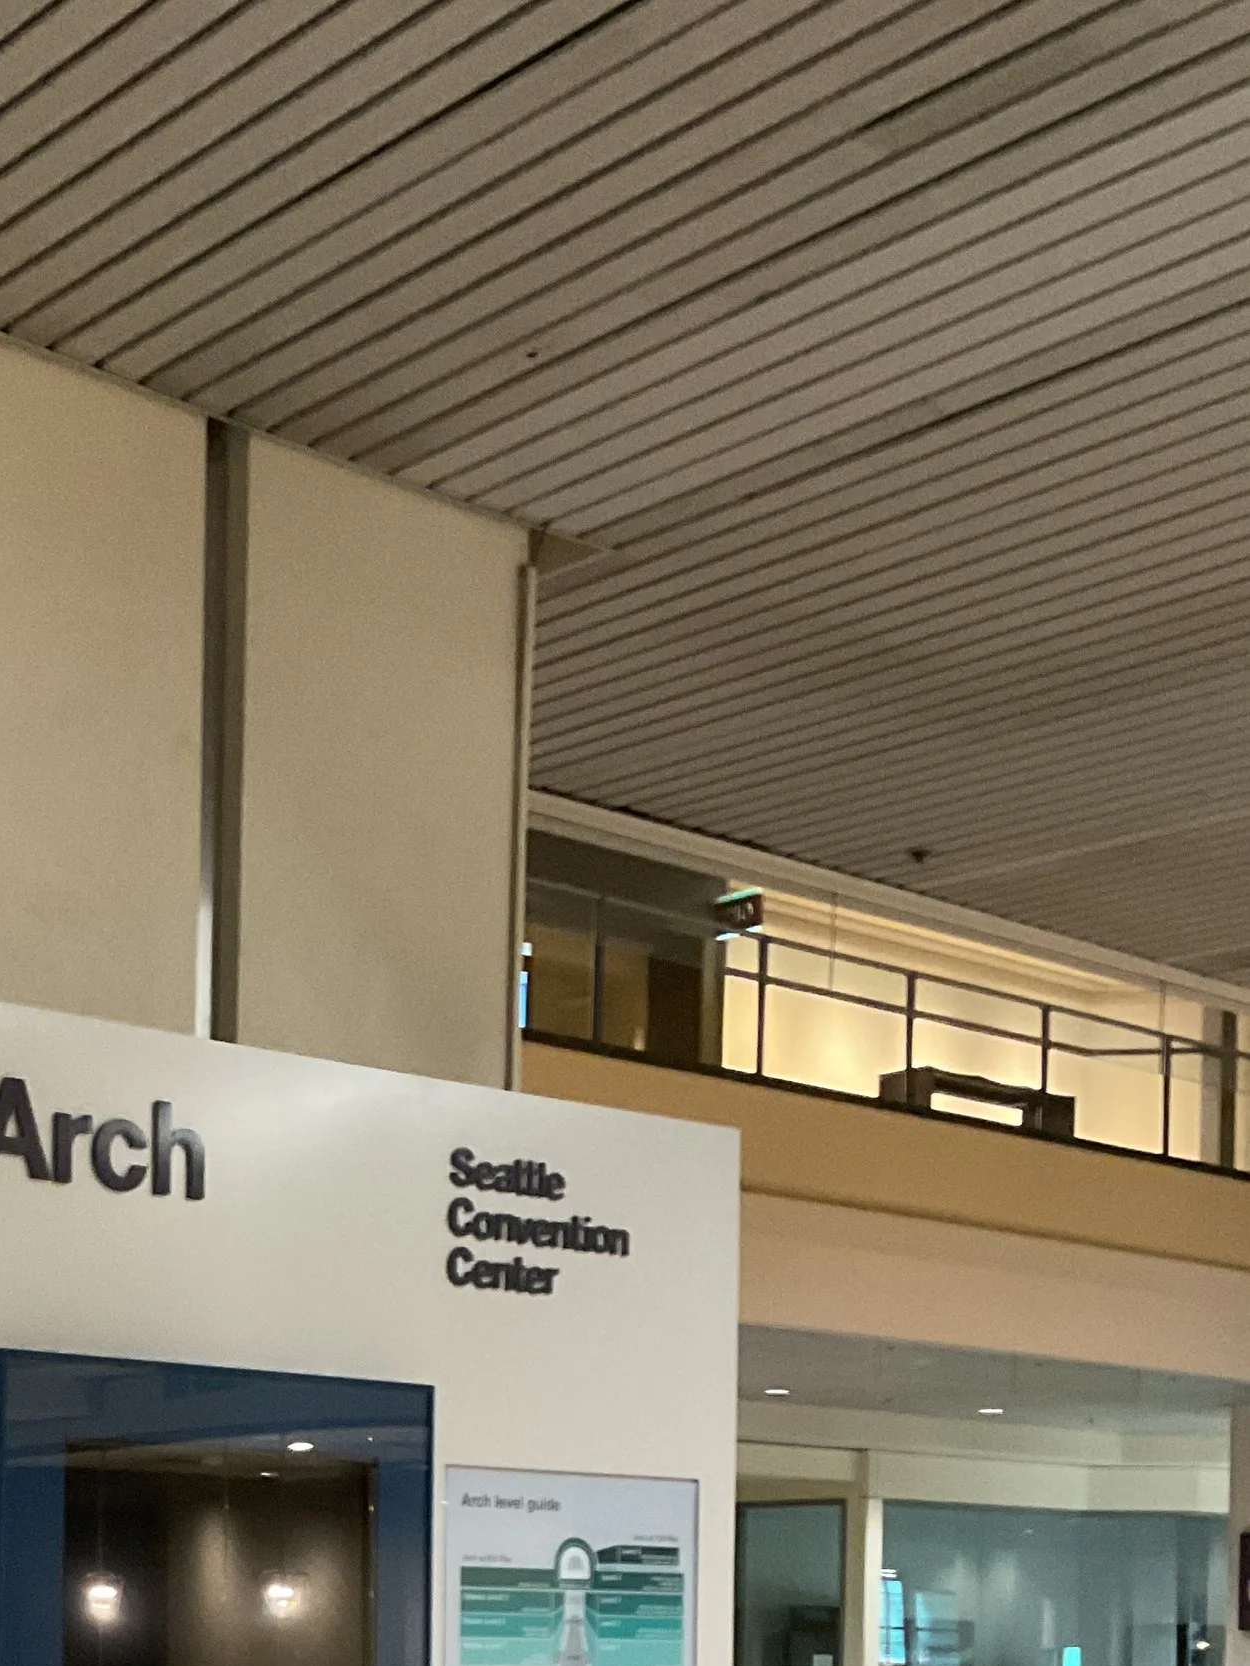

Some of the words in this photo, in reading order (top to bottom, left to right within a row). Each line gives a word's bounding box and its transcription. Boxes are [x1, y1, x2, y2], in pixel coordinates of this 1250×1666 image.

[449, 1147, 566, 1201] Seattle
[447, 1197, 630, 1257] Convention
[446, 1246, 560, 1295] Center
[461, 1492, 491, 1508] Arch
[494, 1494, 524, 1510] level
[526, 1497, 561, 1514] guide
